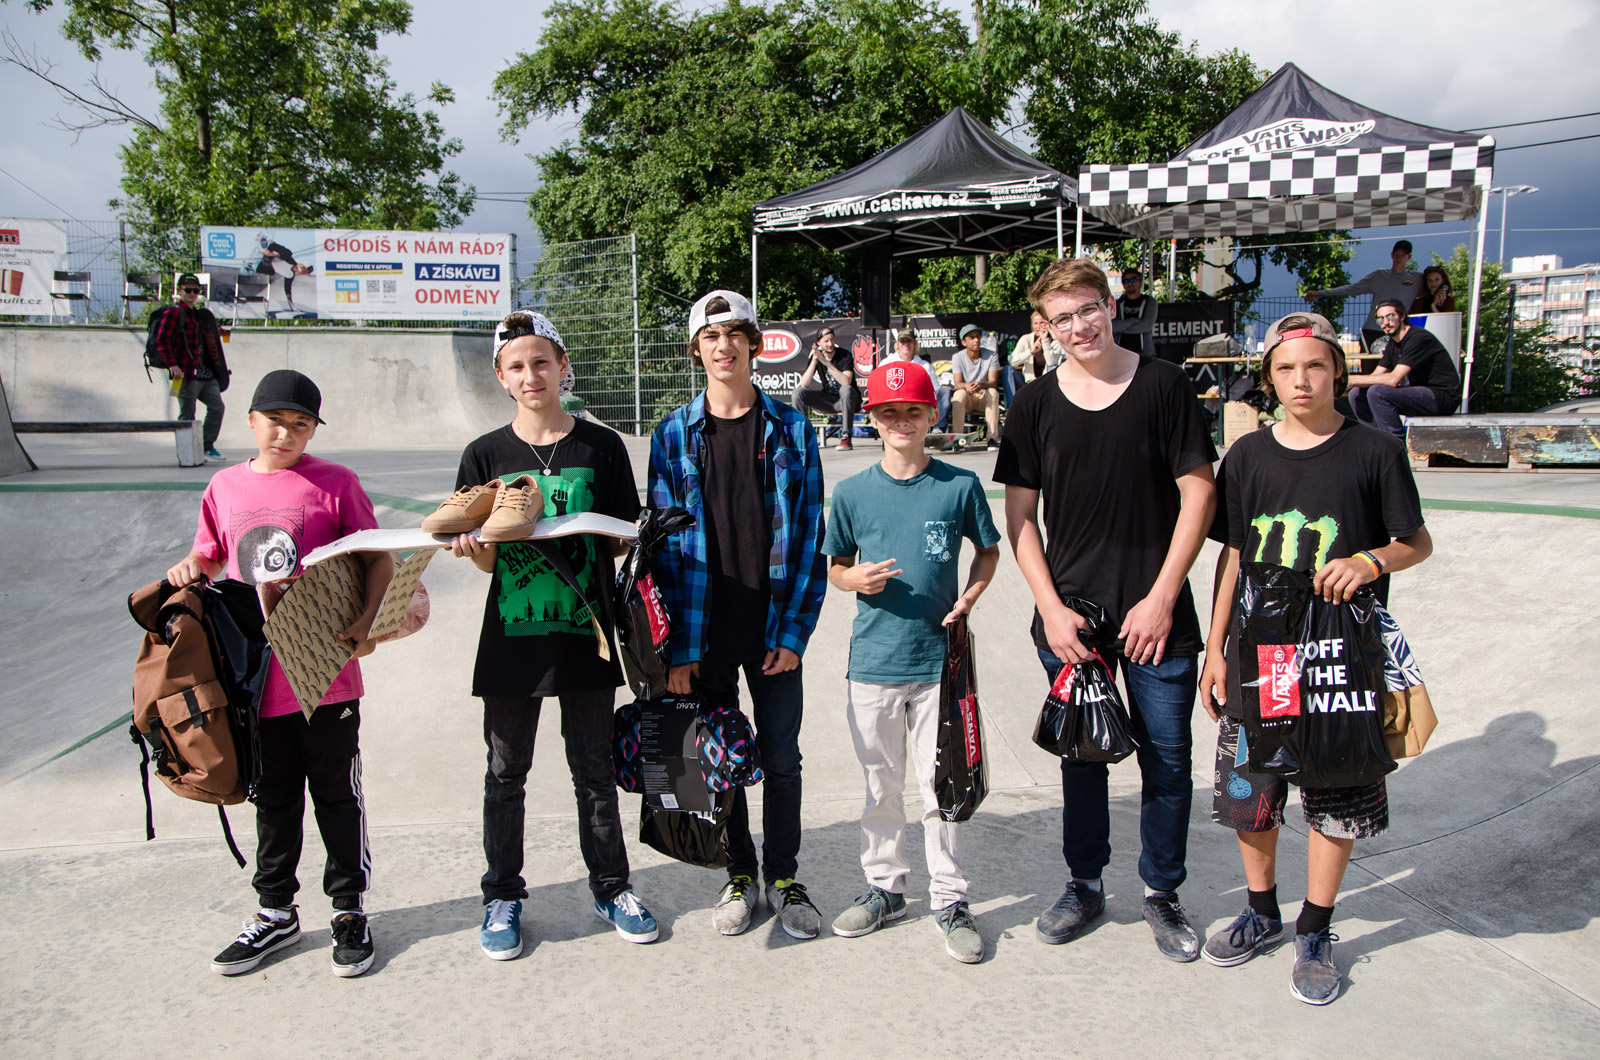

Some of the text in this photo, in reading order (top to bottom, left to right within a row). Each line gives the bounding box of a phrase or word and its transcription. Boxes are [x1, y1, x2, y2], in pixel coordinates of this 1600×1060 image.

[1242, 123, 1305, 144] VANS
[1250, 132, 1299, 153] THE
[823, 192, 970, 218] www.caskate.cz
[212, 238, 231, 248] COOL
[323, 235, 505, 256] CHODÍŠ K NÁM RÁD?
[418, 266, 430, 279] A
[432, 264, 497, 280] ZÍSKÁVEJ
[415, 284, 501, 305] ODMĚNY
[1151, 320, 1224, 337] ELEMENT
[917, 338, 944, 348] TRUCK
[888, 368, 904, 378] SLS
[514, 563, 547, 591] 2014
[1307, 664, 1348, 687] THE
